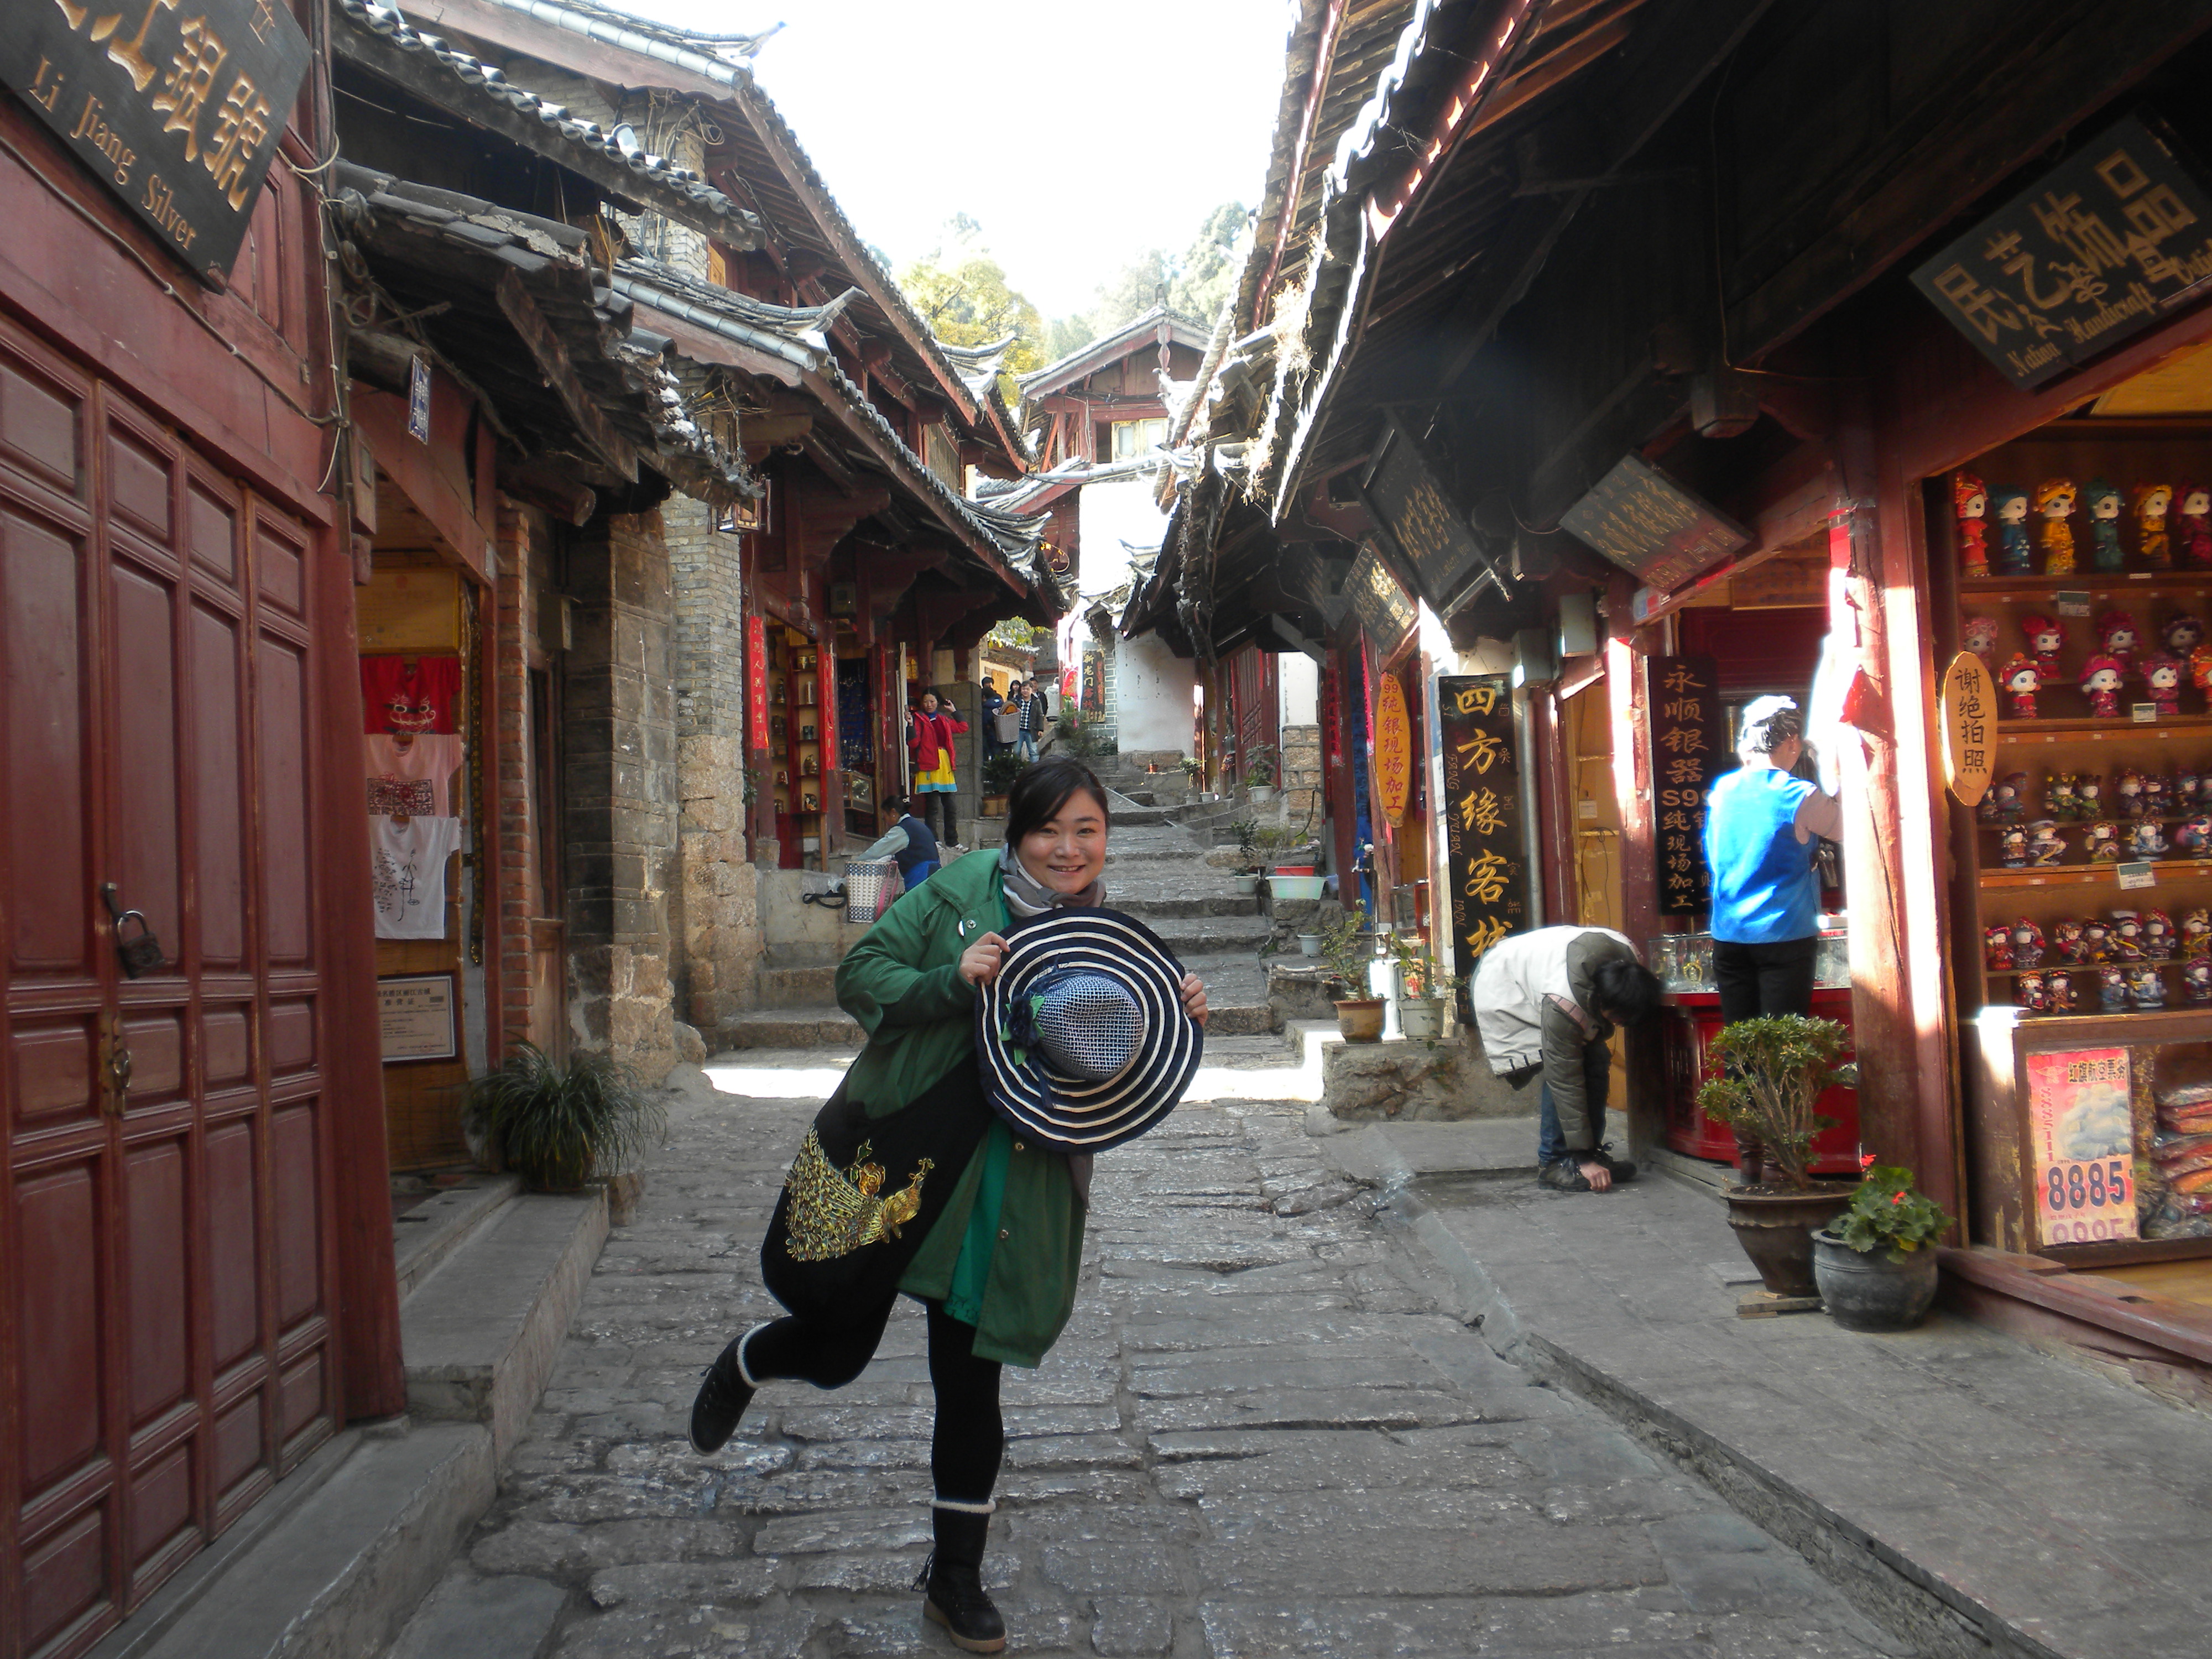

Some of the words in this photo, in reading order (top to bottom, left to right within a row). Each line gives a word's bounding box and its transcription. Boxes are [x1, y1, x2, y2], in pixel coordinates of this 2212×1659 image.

[29, 55, 64, 112] Li
[70, 92, 137, 185] Jiang
[142, 173, 197, 251] Silver
[58, 0, 271, 212] 江銀號
[1933, 149, 2198, 344] 民艺饰品
[1446, 754, 1459, 790] FANG
[1660, 665, 1709, 784] 永顺银器
[1955, 668, 1987, 774] 谢绝拍照
[2068, 1057, 2126, 1083] 红旗航空票务
